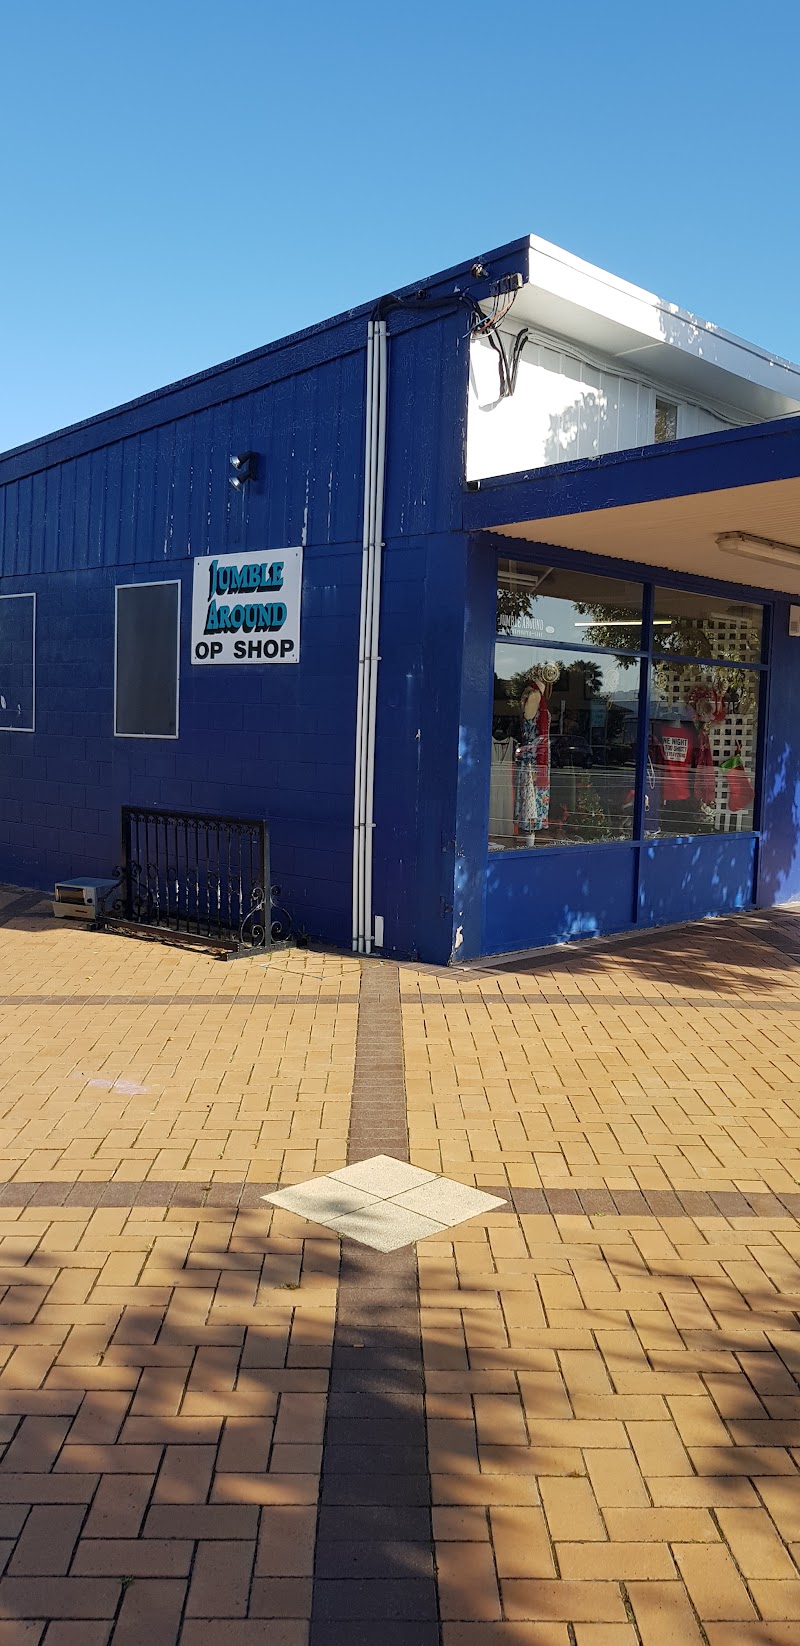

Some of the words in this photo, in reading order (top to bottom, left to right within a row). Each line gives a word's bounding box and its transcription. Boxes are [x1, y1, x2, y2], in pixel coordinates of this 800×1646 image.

[208, 560, 284, 602] JUMBLE
[204, 599, 287, 635] AROUND
[195, 642, 223, 659] OP
[234, 640, 294, 658] SHOP
